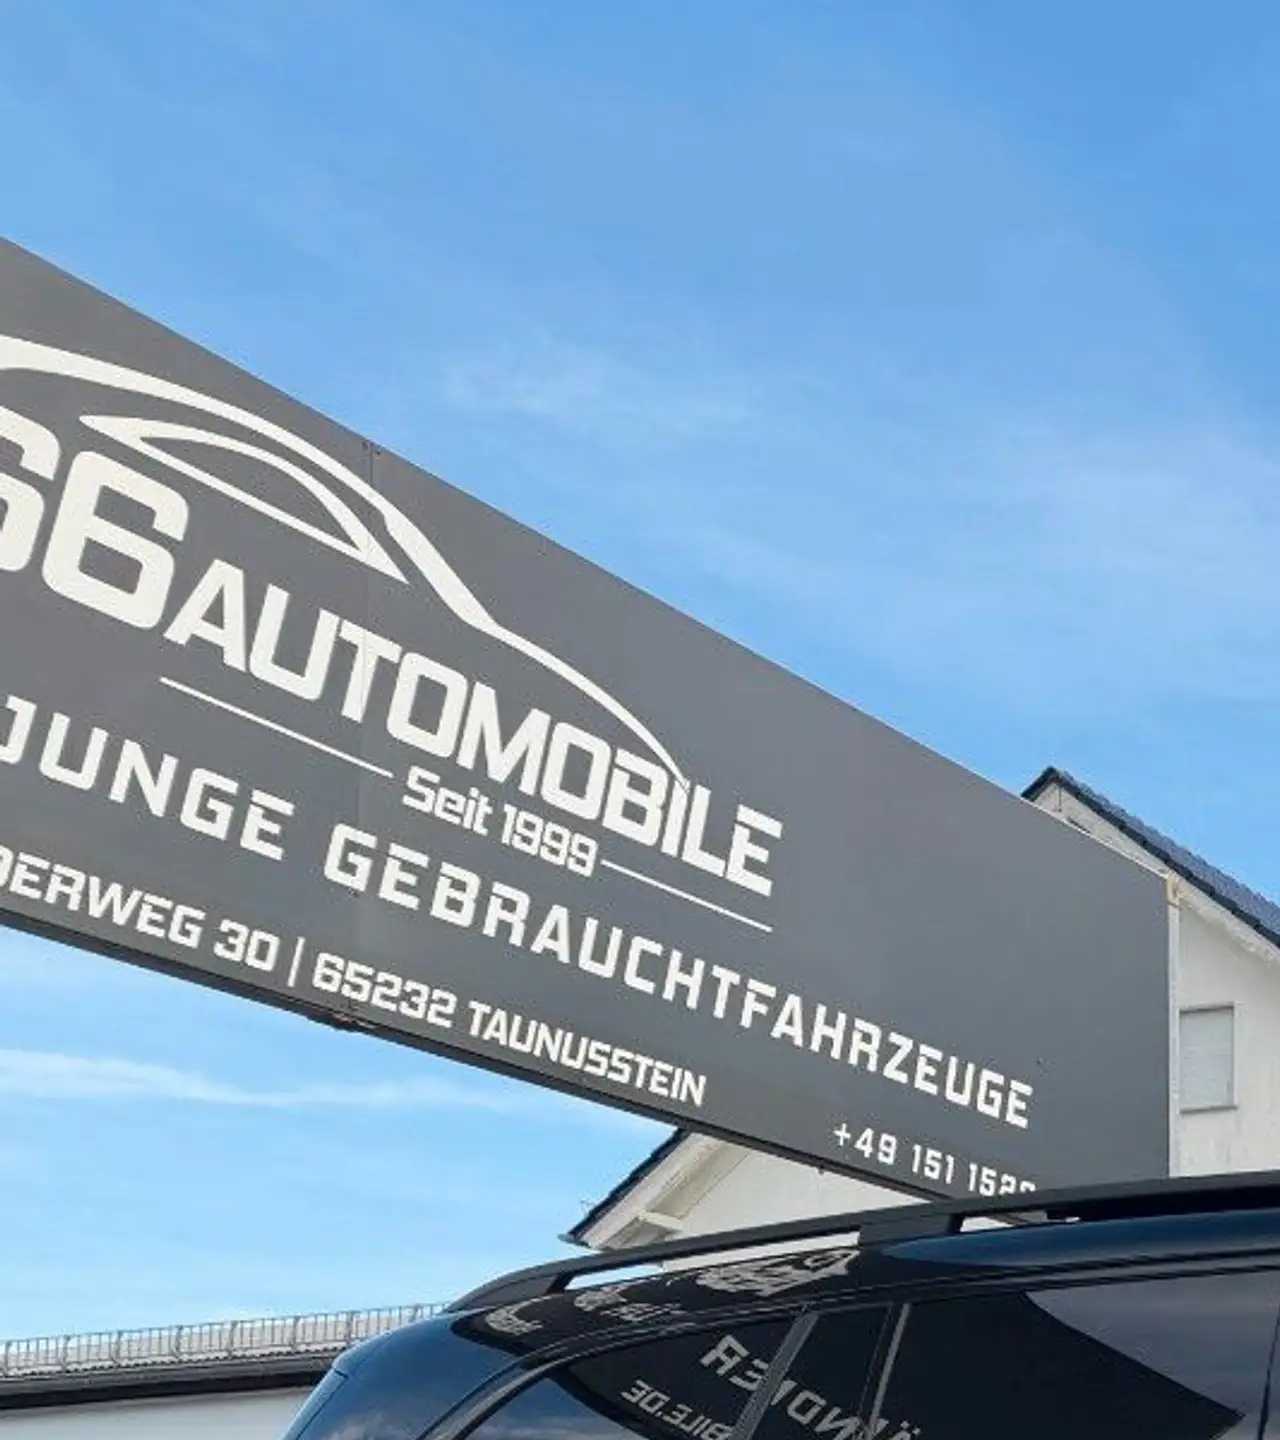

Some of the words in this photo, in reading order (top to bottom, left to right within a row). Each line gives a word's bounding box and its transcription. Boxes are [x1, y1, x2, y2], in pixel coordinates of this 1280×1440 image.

[402, 764, 493, 848] Seit
[500, 803, 600, 879] 1999
[0, 693, 296, 862] JUNGE
[322, 822, 1034, 1130] GEBRAUCHTFAHRZEUGE
[213, 918, 281, 973] 30
[312, 951, 459, 1030] 65232
[467, 999, 708, 1108] TAUNUSSTEIN
[833, 1122, 898, 1166] +49
[911, 1144, 956, 1185] 151
